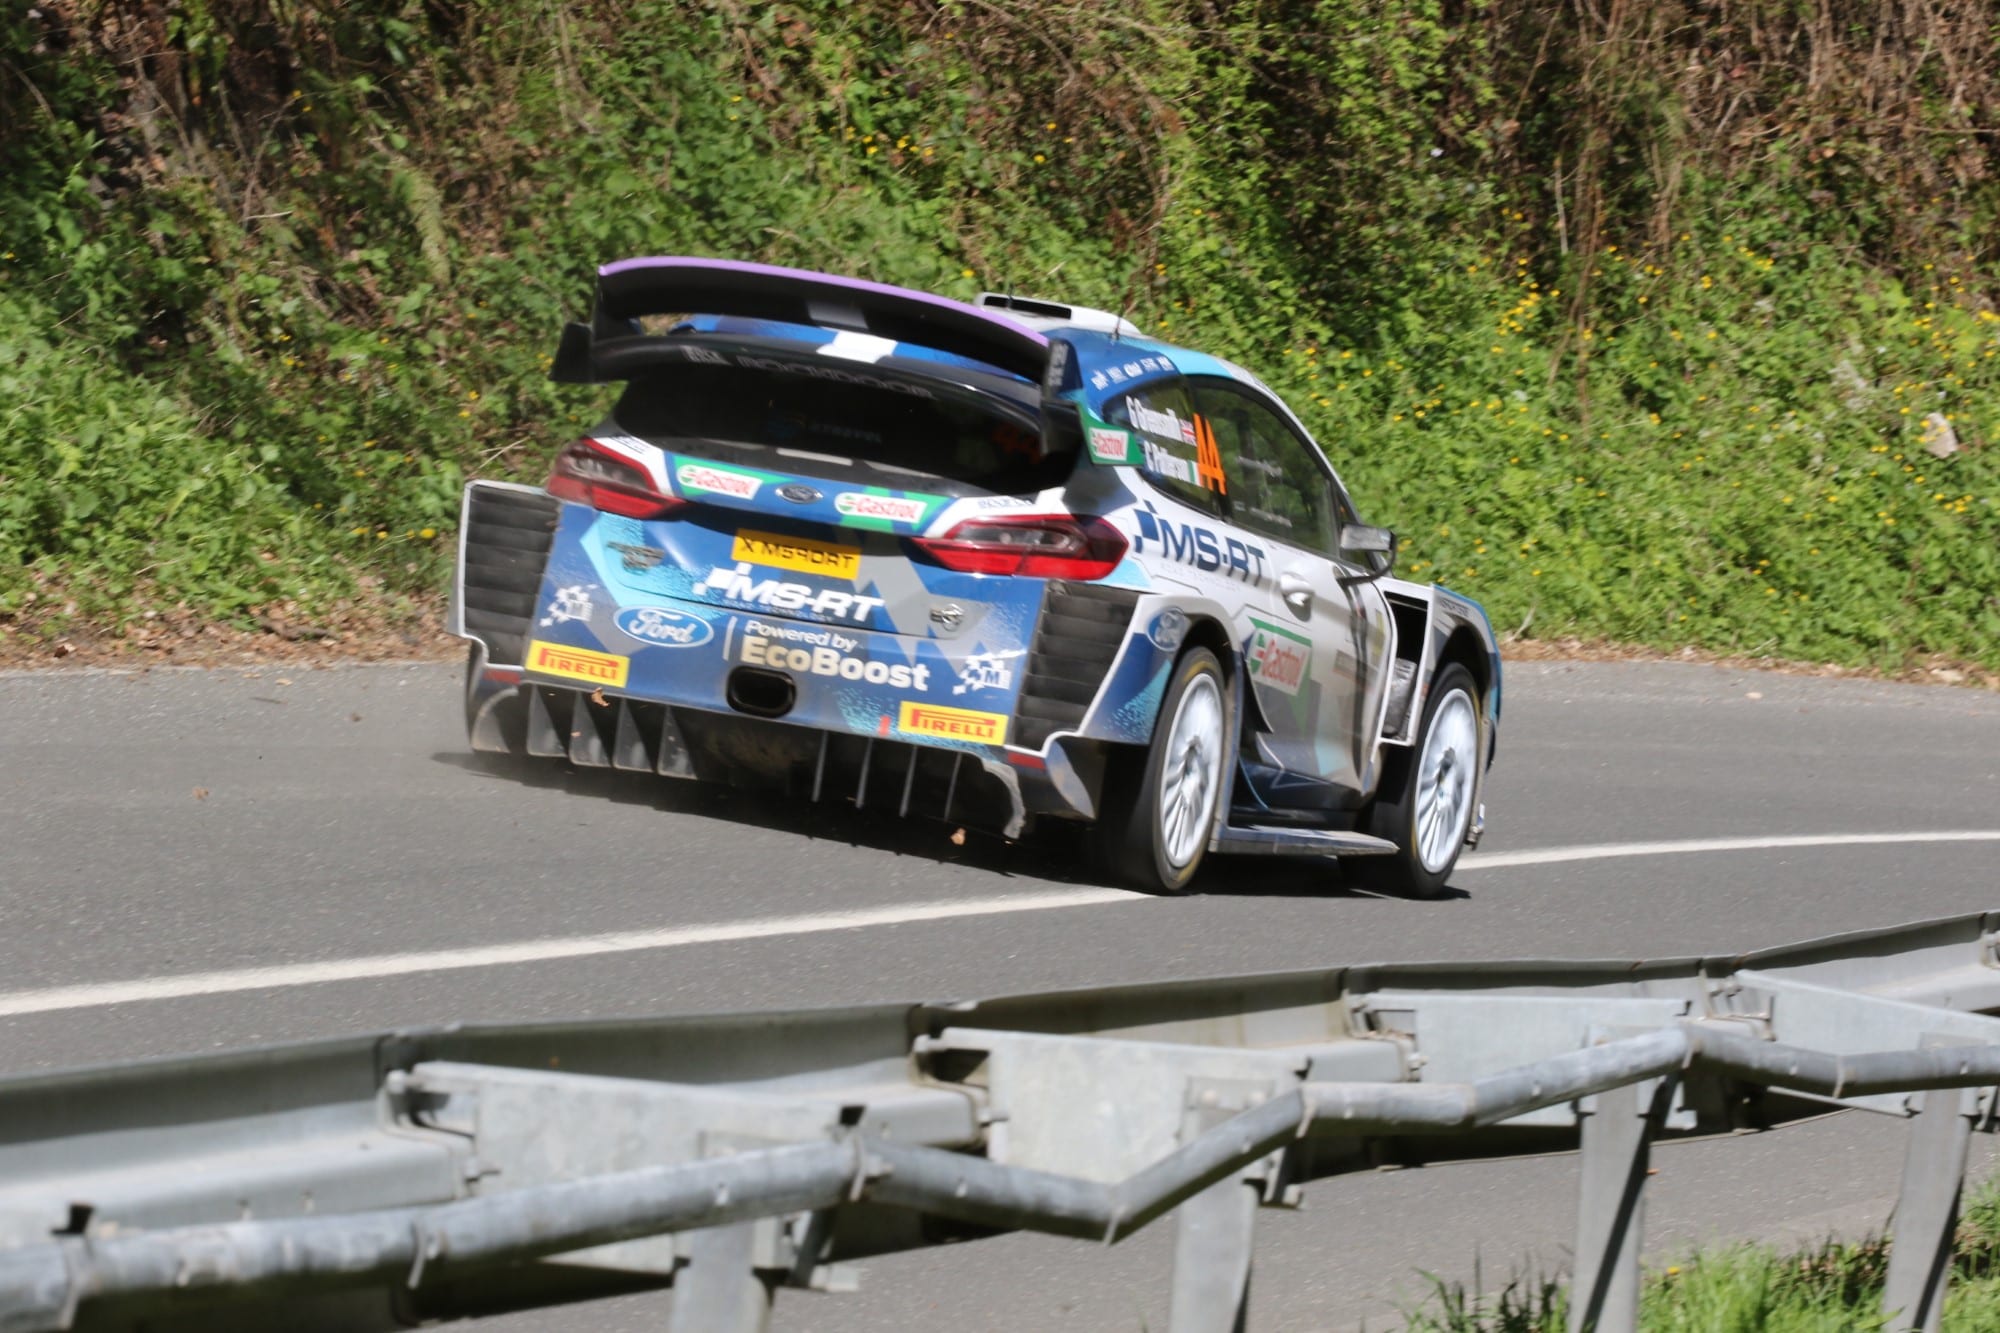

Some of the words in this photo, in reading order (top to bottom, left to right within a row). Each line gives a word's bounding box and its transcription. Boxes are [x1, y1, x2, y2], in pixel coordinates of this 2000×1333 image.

[1193, 412, 1227, 496] 44
[857, 497, 918, 520] Castrol
[727, 573, 884, 621] MS-RT
[629, 608, 697, 643] Ford
[744, 619, 832, 647] Powered
[831, 632, 858, 653] by
[539, 646, 620, 681] PIRELLI
[740, 634, 931, 692] EcoBoost
[911, 708, 997, 739] PIRELLI
